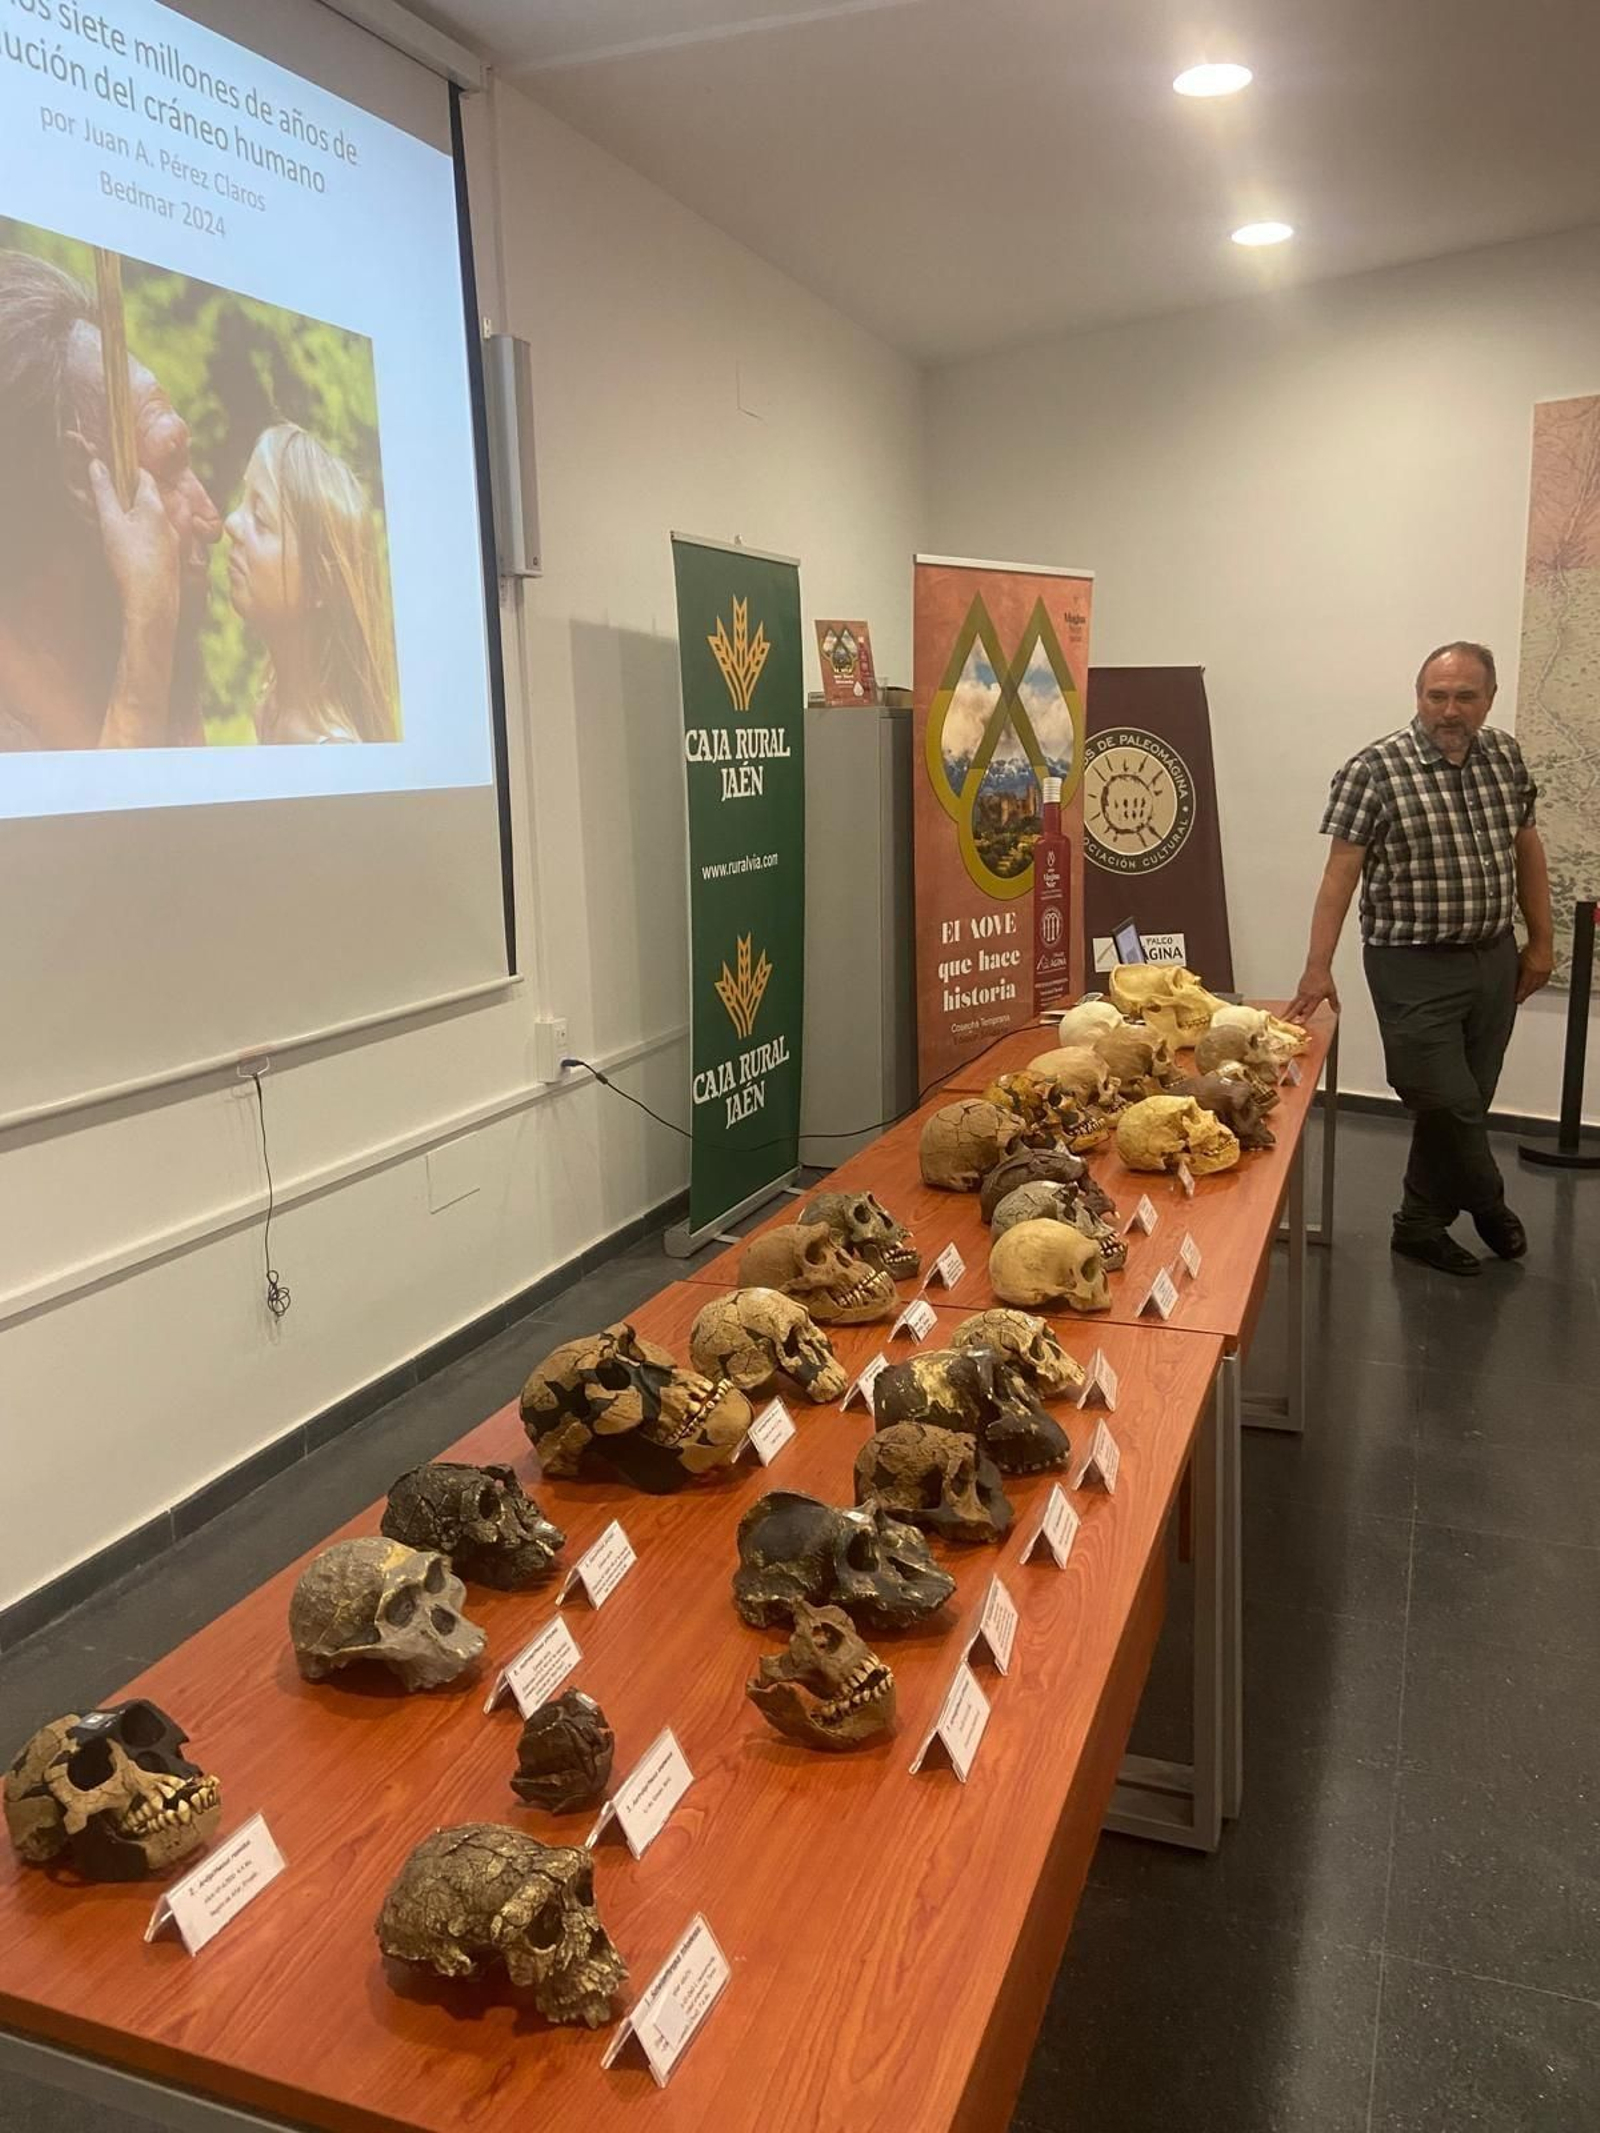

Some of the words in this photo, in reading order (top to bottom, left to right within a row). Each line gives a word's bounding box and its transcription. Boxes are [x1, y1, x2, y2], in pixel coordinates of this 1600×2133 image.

[59, 0, 126, 56] siete
[134, 38, 240, 110] millones
[245, 87, 273, 126] de
[279, 107, 329, 152] años
[333, 130, 358, 166] de
[0, 31, 87, 91] ución
[94, 65, 136, 112] del
[144, 95, 229, 151] cráneo
[234, 125, 326, 194] humano
[41, 106, 76, 134] por
[84, 118, 130, 158] Juan
[135, 139, 155, 168] A.
[160, 149, 209, 190] Pérez
[214, 172, 267, 212] Claros
[100, 170, 174, 219] Bedmar
[182, 202, 226, 237] 2024
[685, 729, 732, 764] CAJA
[735, 728, 790, 759] RURAL
[1097, 736, 1116, 751] DE
[1119, 734, 1189, 800] PALEOMÁGINA
[721, 761, 764, 802] JAÉN
[702, 853, 778, 880] www.ruralvia.com
[1142, 819, 1189, 866] CULTURAL
[941, 920, 961, 945] El
[970, 911, 1017, 940] AOVE
[938, 958, 972, 984] que
[978, 949, 1021, 972] hace
[943, 977, 1017, 1012] historia
[693, 1061, 736, 1105] CAJA
[739, 1035, 790, 1085] RURAL
[725, 1080, 765, 1130] JAÉN
